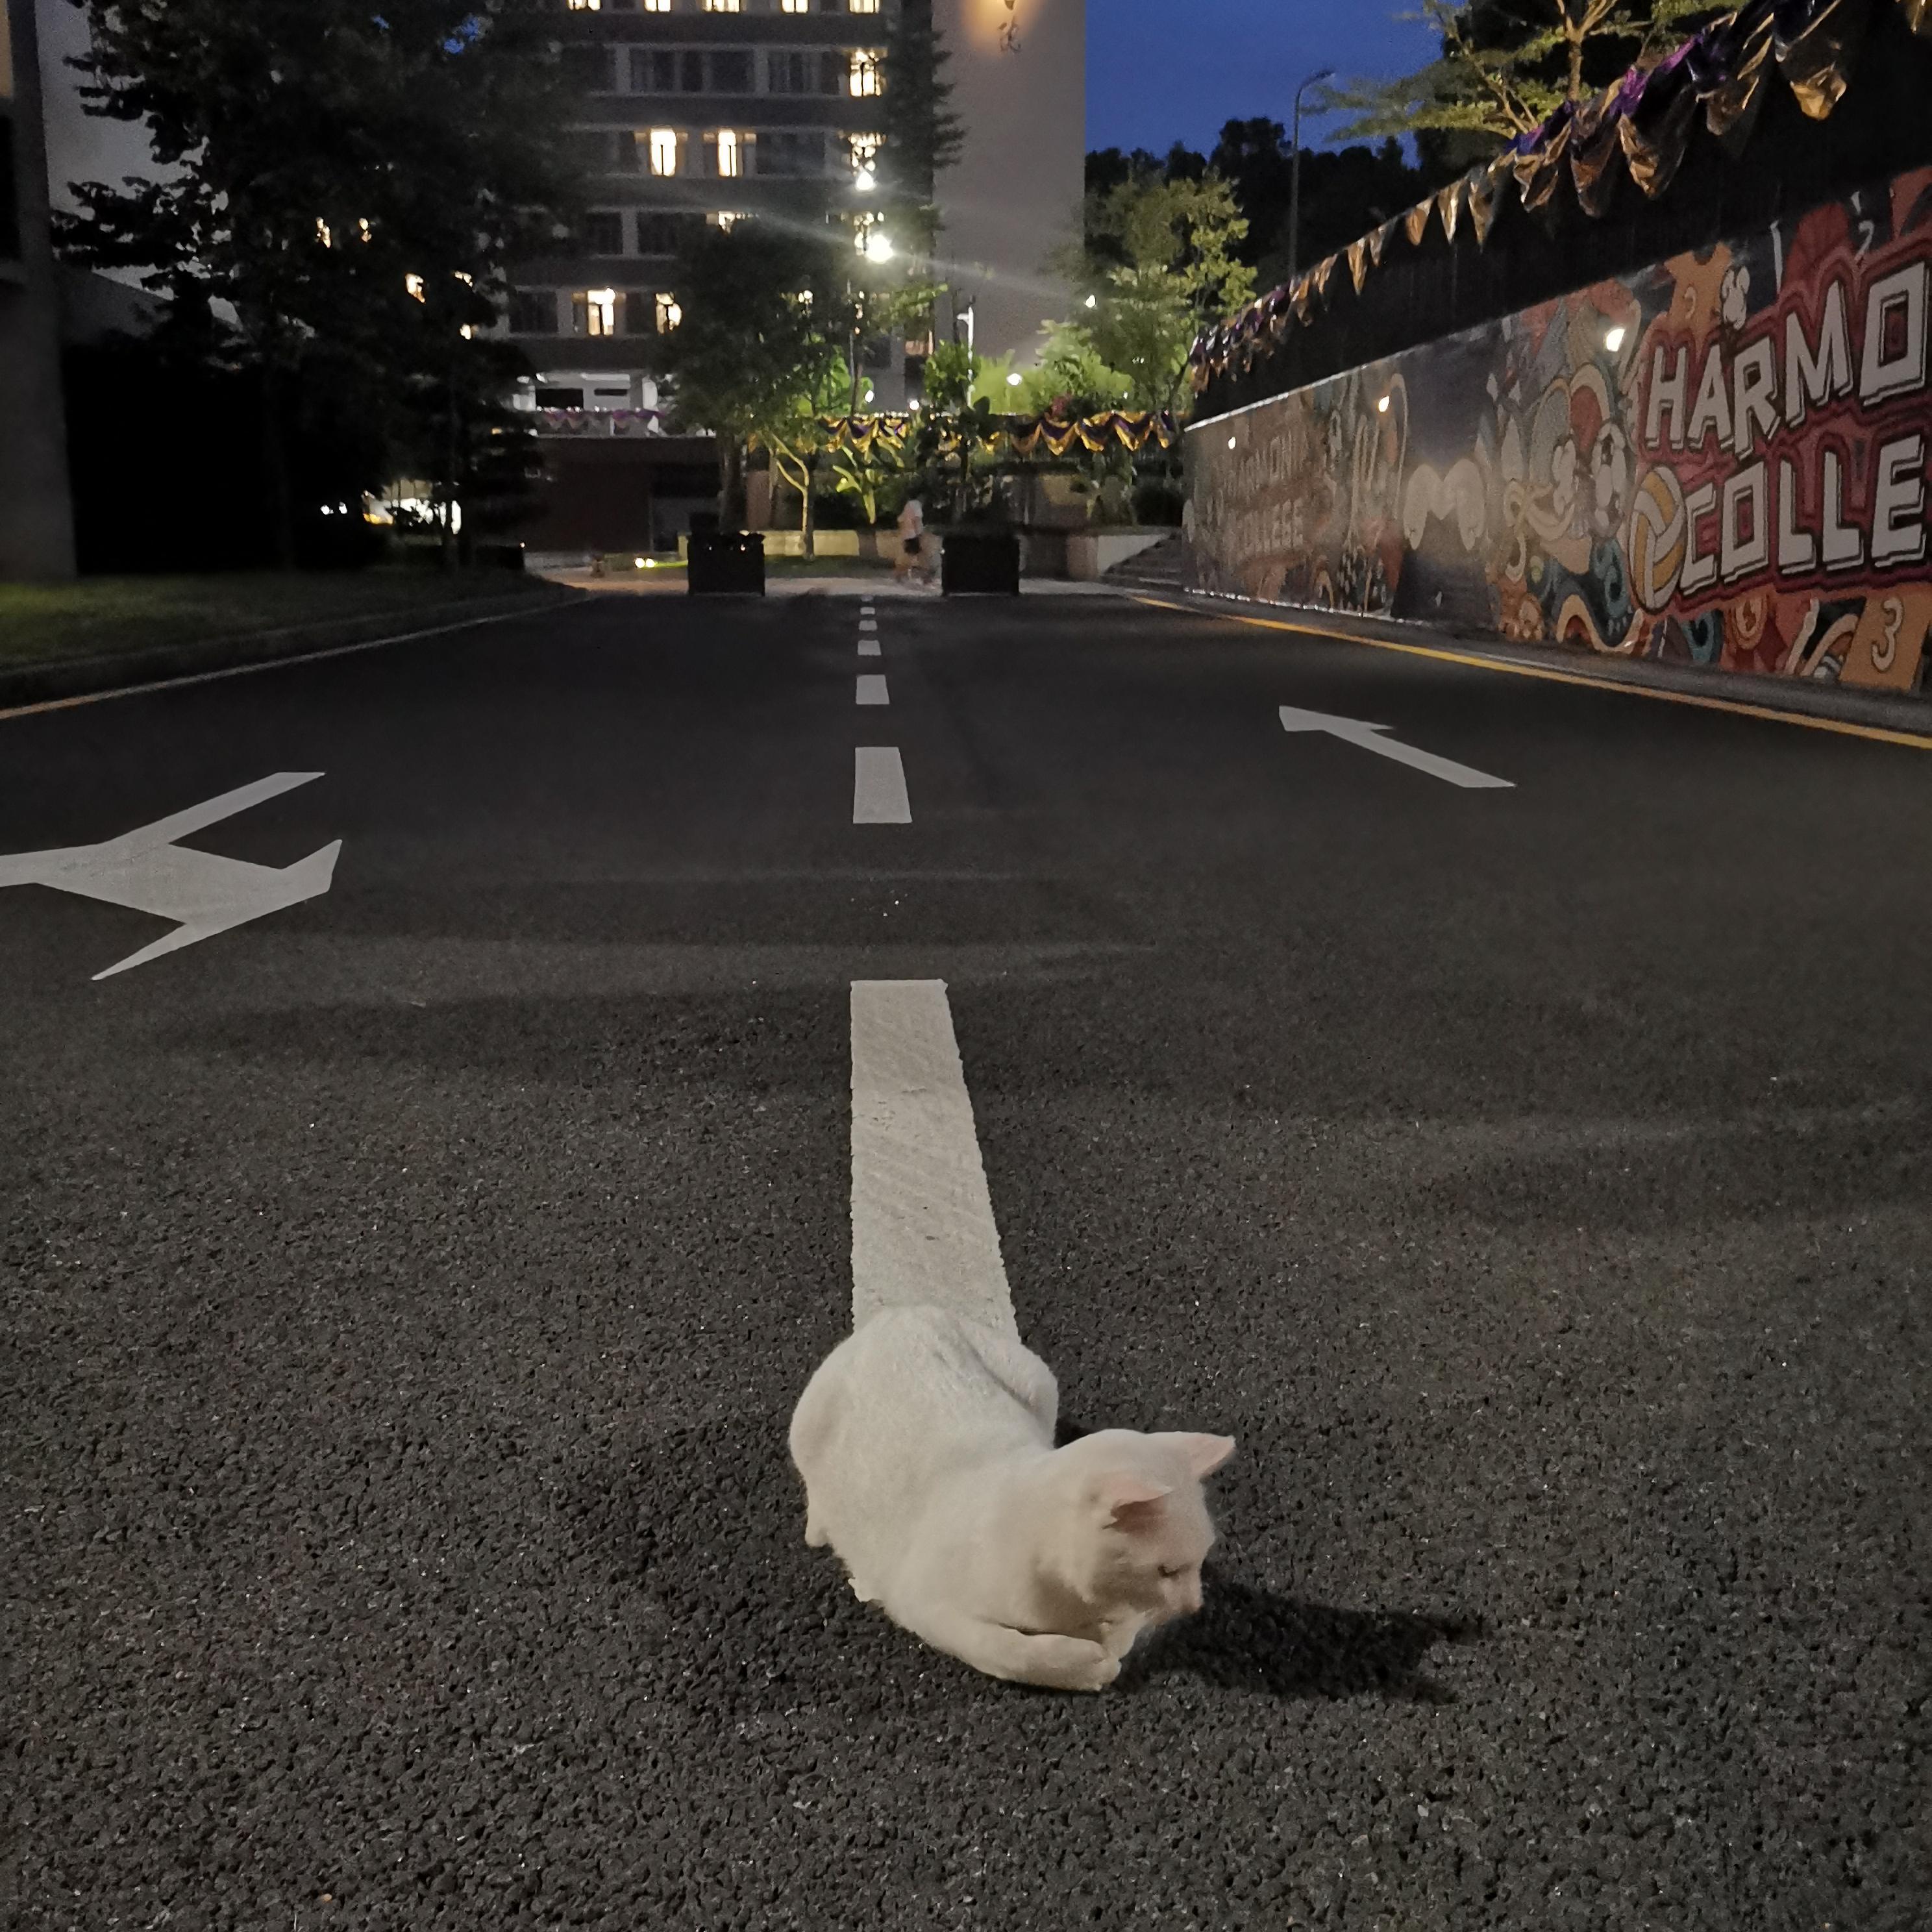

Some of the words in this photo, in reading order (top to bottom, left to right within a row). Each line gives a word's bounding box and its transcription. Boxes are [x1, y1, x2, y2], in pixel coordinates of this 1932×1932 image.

[1644, 261, 1929, 462] HARMO
[1681, 434, 1926, 595] COLLE
[1870, 596, 1903, 673] 3
